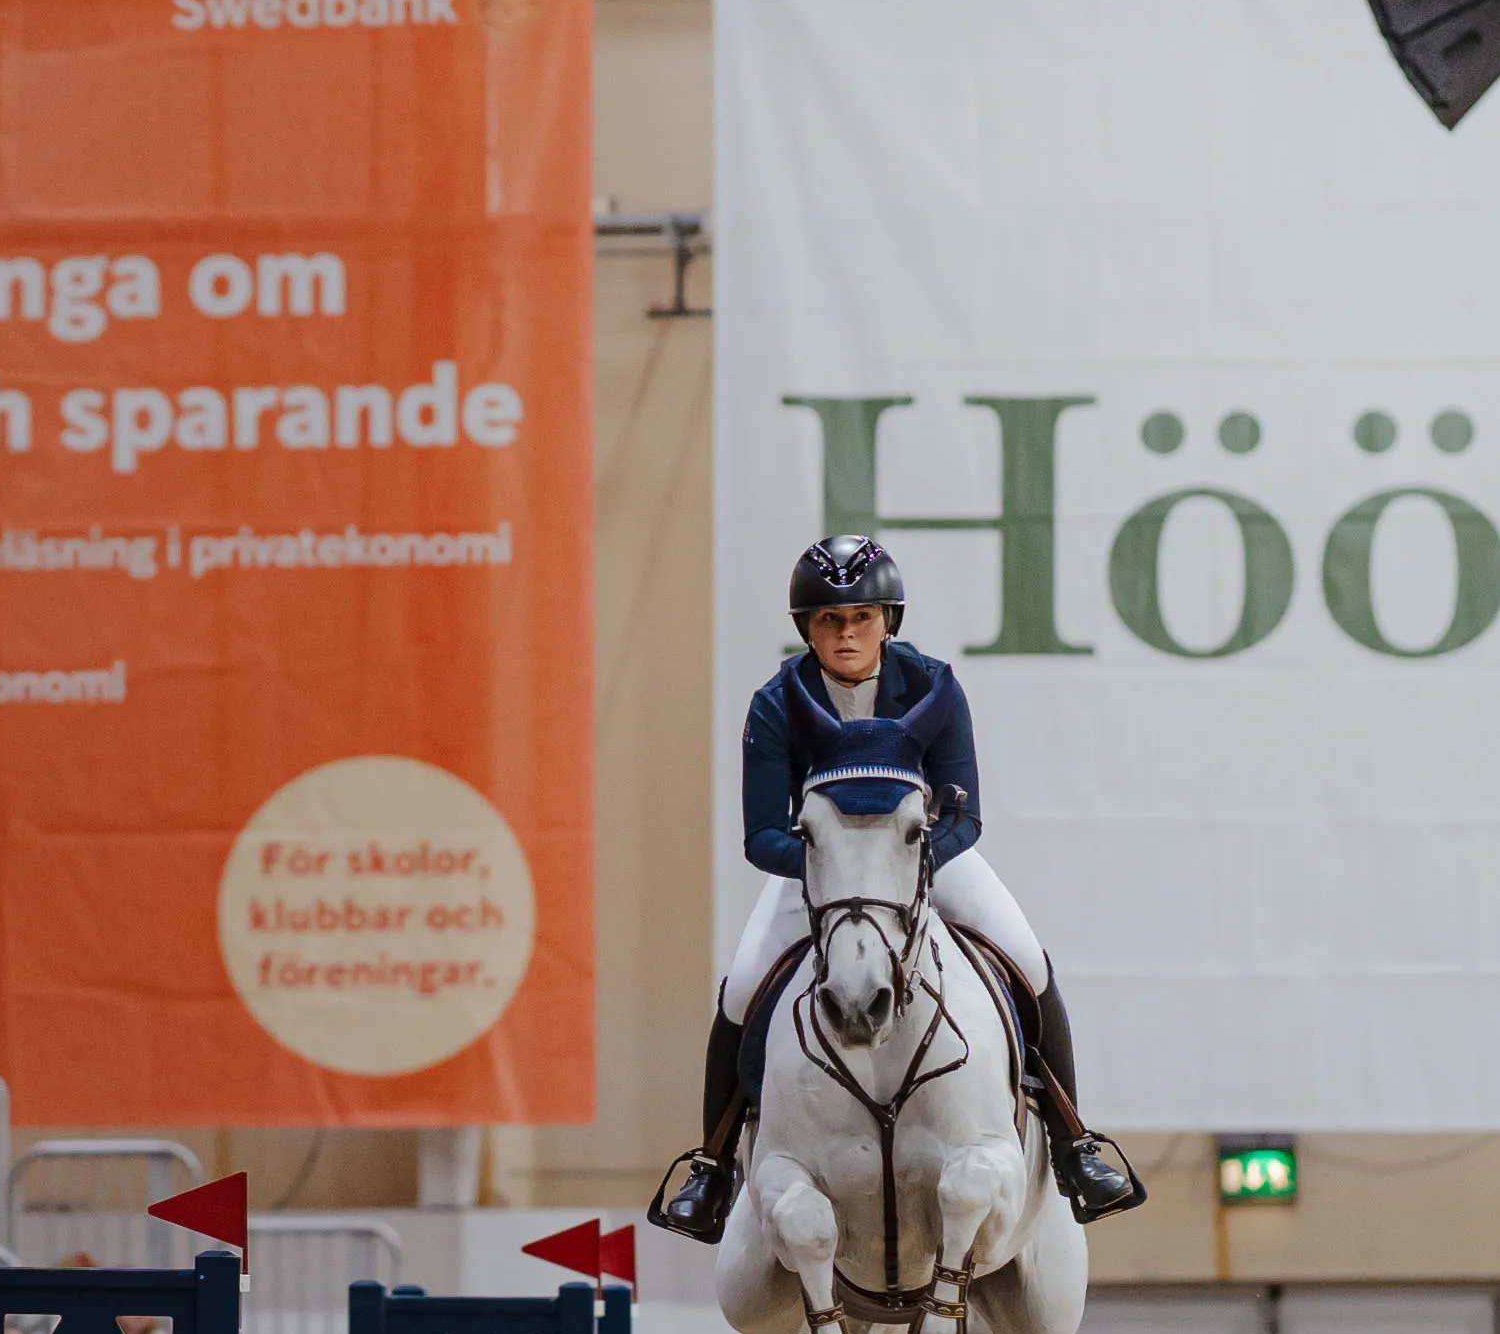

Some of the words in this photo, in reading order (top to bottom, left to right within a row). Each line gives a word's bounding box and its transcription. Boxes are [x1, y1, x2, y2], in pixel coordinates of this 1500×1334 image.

[189, 252, 347, 319] om
[60, 362, 524, 473] sparande
[167, 526, 181, 568] i
[190, 524, 512, 578] privatekonomi
[259, 841, 333, 878] För
[248, 897, 414, 934] klubbar
[424, 897, 506, 933] och
